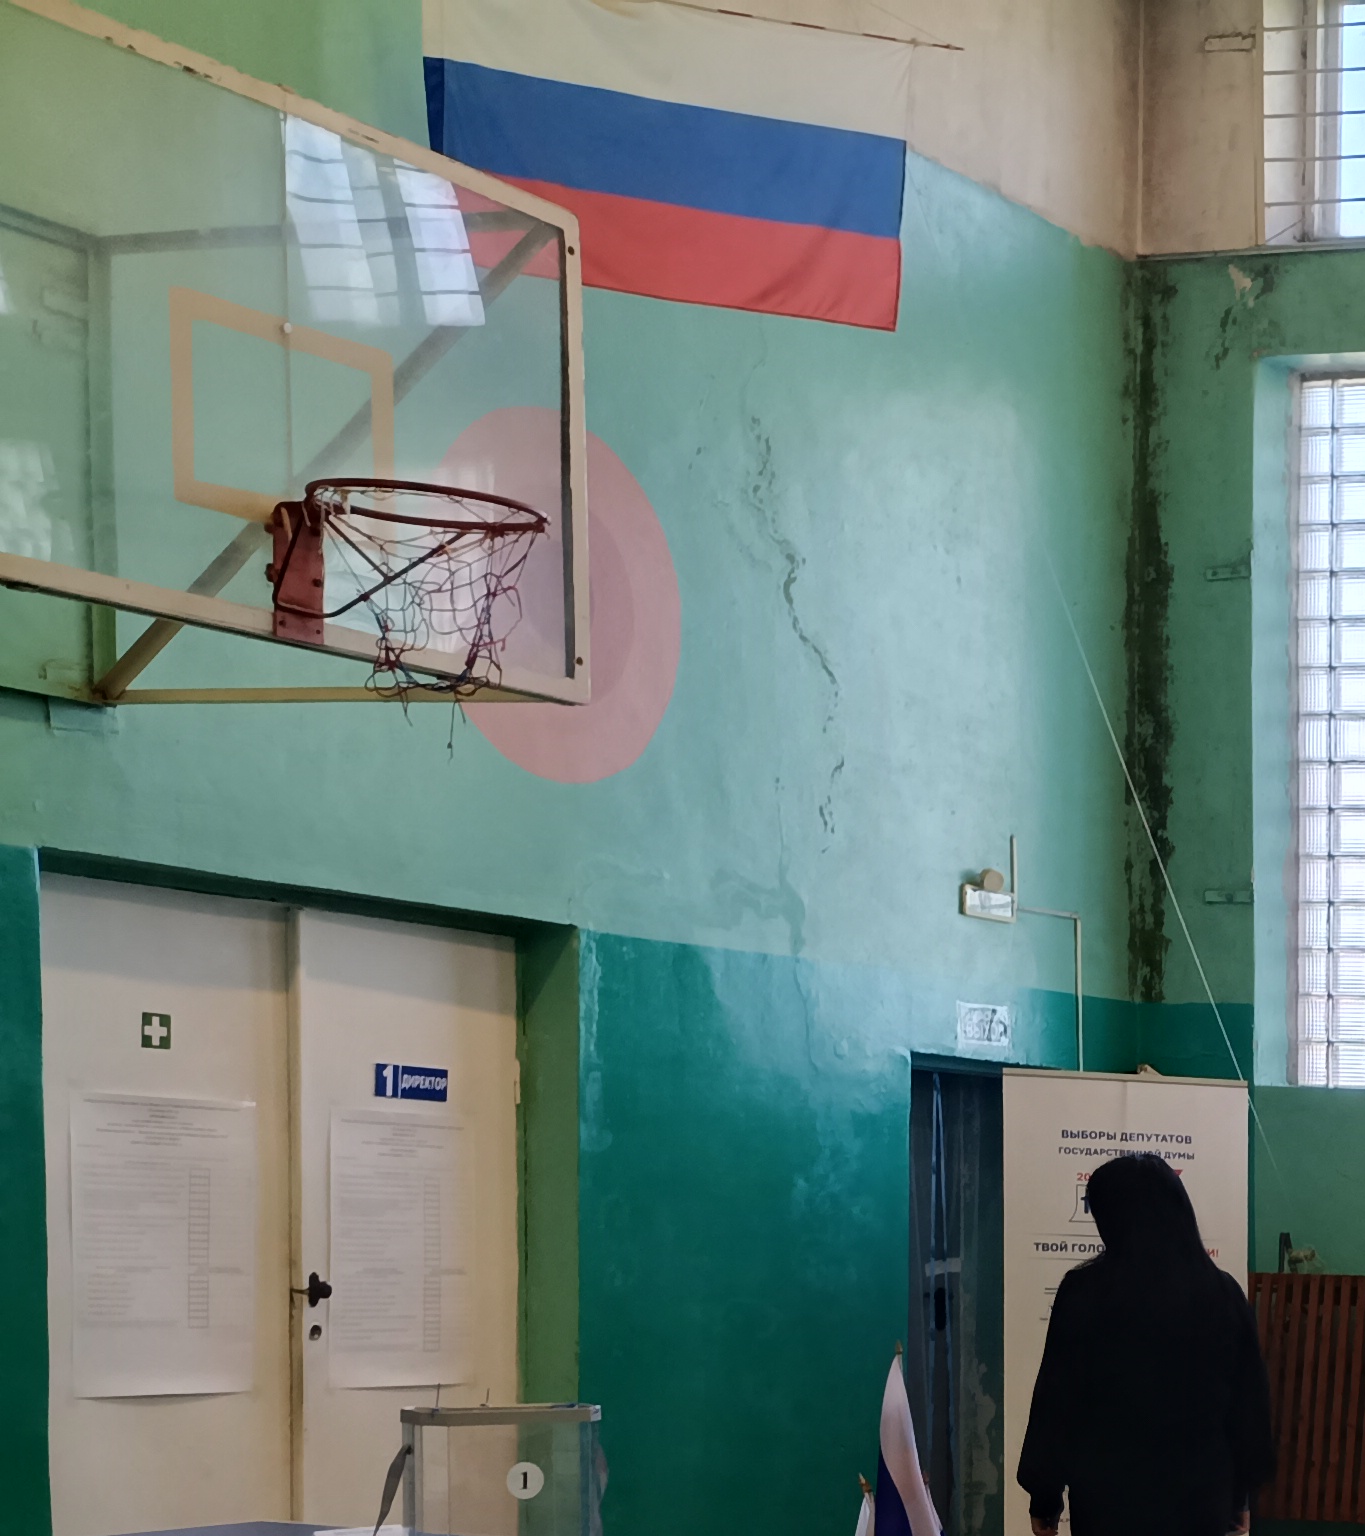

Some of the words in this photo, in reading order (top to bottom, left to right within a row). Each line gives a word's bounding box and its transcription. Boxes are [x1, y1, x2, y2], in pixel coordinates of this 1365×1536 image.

[382, 1065, 394, 1096] 1
[401, 1073, 447, 1090] ДИРЕКТОР
[1061, 1129, 1117, 1141] ВЫБОРЫ
[1120, 1132, 1192, 1145] ДЕПУТАТОВ
[1164, 1151, 1195, 1160] ДУМЫ
[1033, 1240, 1068, 1253] ТВОЙ
[1071, 1242, 1106, 1254] ГОЛО
[520, 1471, 528, 1490] 1
